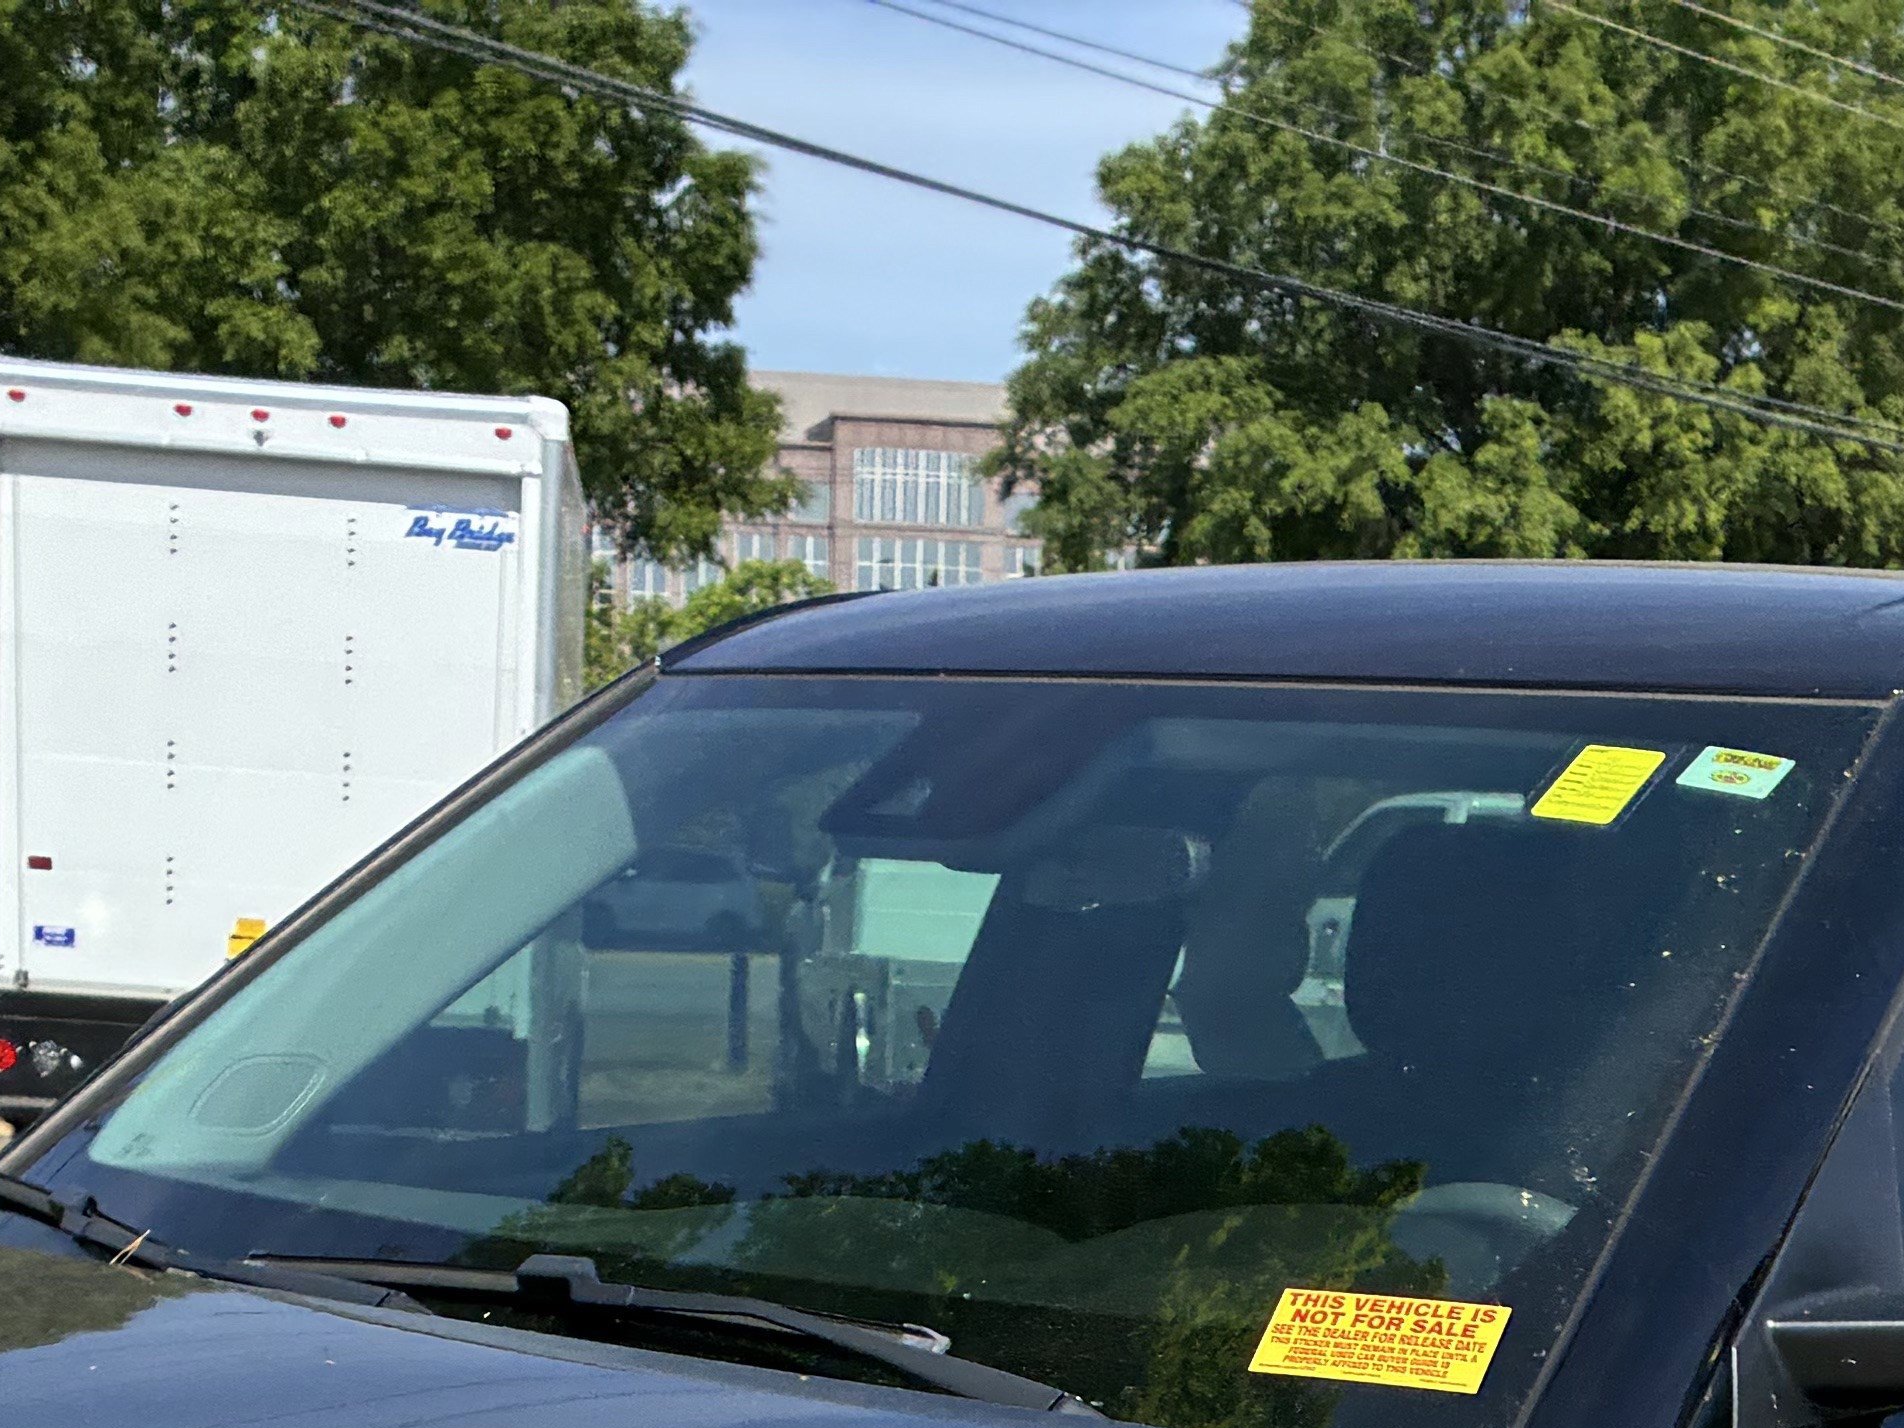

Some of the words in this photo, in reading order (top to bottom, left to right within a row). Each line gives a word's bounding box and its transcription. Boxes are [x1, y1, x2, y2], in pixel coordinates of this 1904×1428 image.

[405, 516, 446, 546] Bay
[448, 519, 515, 544] Bridge
[1290, 1293, 1346, 1309] THIS
[1356, 1297, 1465, 1320] VEHICLE
[1471, 1308, 1498, 1323] IS
[1290, 1309, 1346, 1326] NOT
[1350, 1313, 1404, 1331] FOR
[1410, 1319, 1480, 1338] SALE
[1271, 1324, 1295, 1335] SEE
[1297, 1325, 1321, 1338] THE
[1322, 1327, 1370, 1342] DEALER
[1371, 1331, 1397, 1344] FOR
[1398, 1334, 1453, 1350] RELEASE
[1455, 1340, 1487, 1353] DATE
[1357, 1353, 1375, 1361] CAR
[1371, 1362, 1384, 1371] TO
[1410, 1349, 1440, 1358] PLACE
[1471, 1354, 1478, 1362] A
